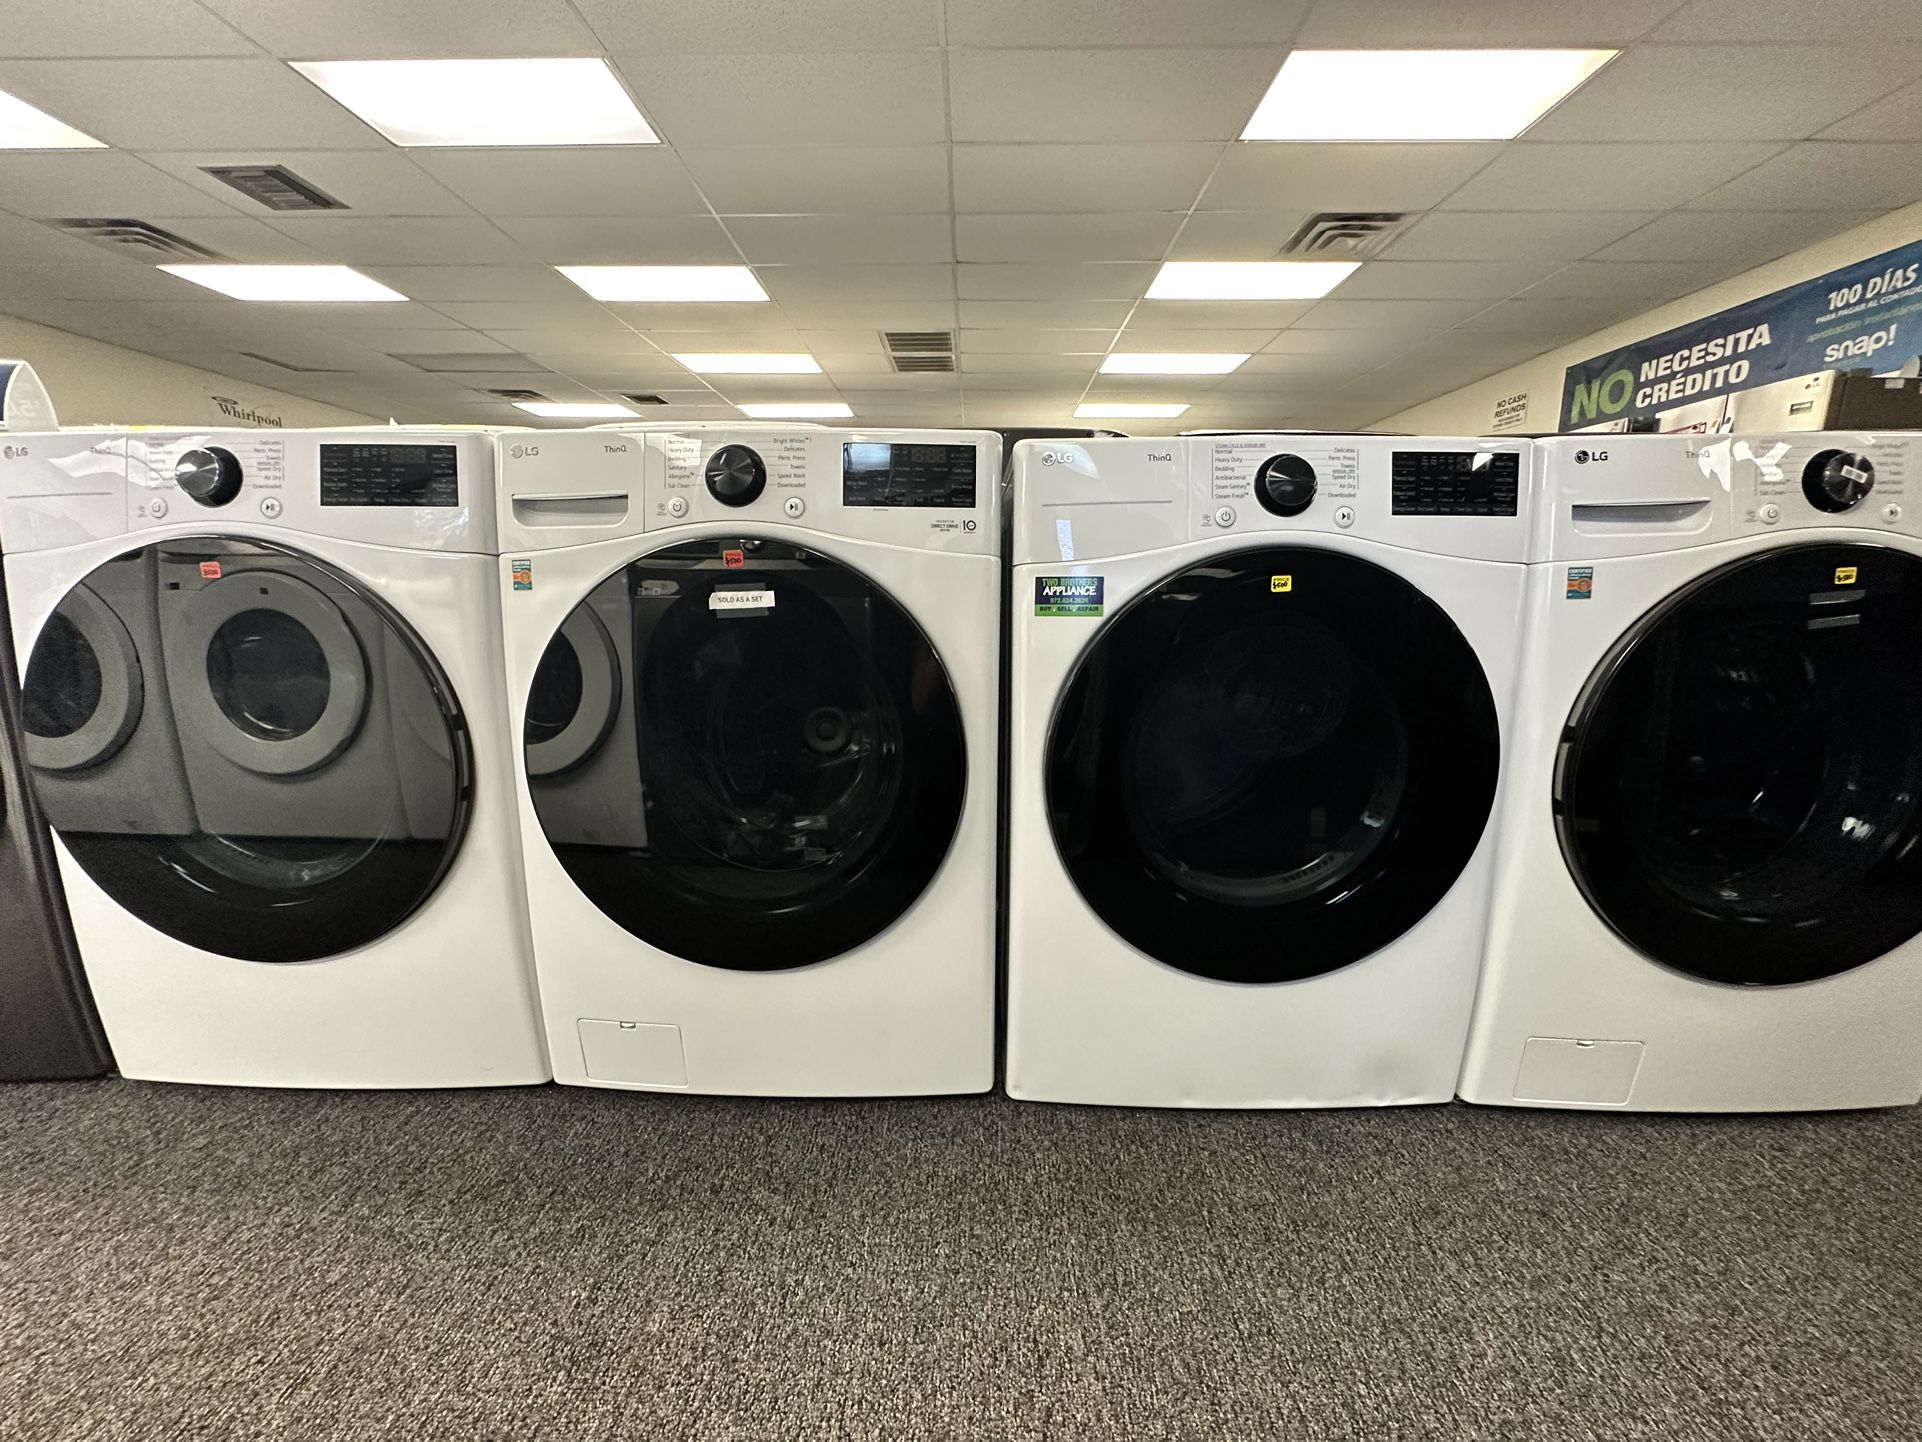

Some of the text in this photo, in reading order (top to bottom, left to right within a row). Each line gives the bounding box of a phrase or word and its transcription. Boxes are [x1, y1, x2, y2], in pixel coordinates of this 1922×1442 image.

[1828, 263, 1919, 310] 100 DÍAS
[1824, 323, 1897, 362] snap!
[1639, 323, 1771, 383] NECESITA
[1635, 359, 1750, 408] CRÉDITO
[1497, 393, 1527, 409] NO CASH
[1571, 369, 1634, 424] NO
[217, 402, 282, 427] Whirlpool
[1494, 402, 1526, 418] REFUNDS
[15, 447, 28, 456] LG
[525, 447, 539, 456] LG
[604, 445, 627, 453] ThinQ
[1057, 453, 1073, 463] LG
[1148, 453, 1172, 462] ThinQ
[1592, 451, 1608, 461] LG
[963, 520, 976, 531] 10
[1042, 578, 1098, 586] TWO BROTHERS
[1043, 586, 1096, 596] APPLIANCE
